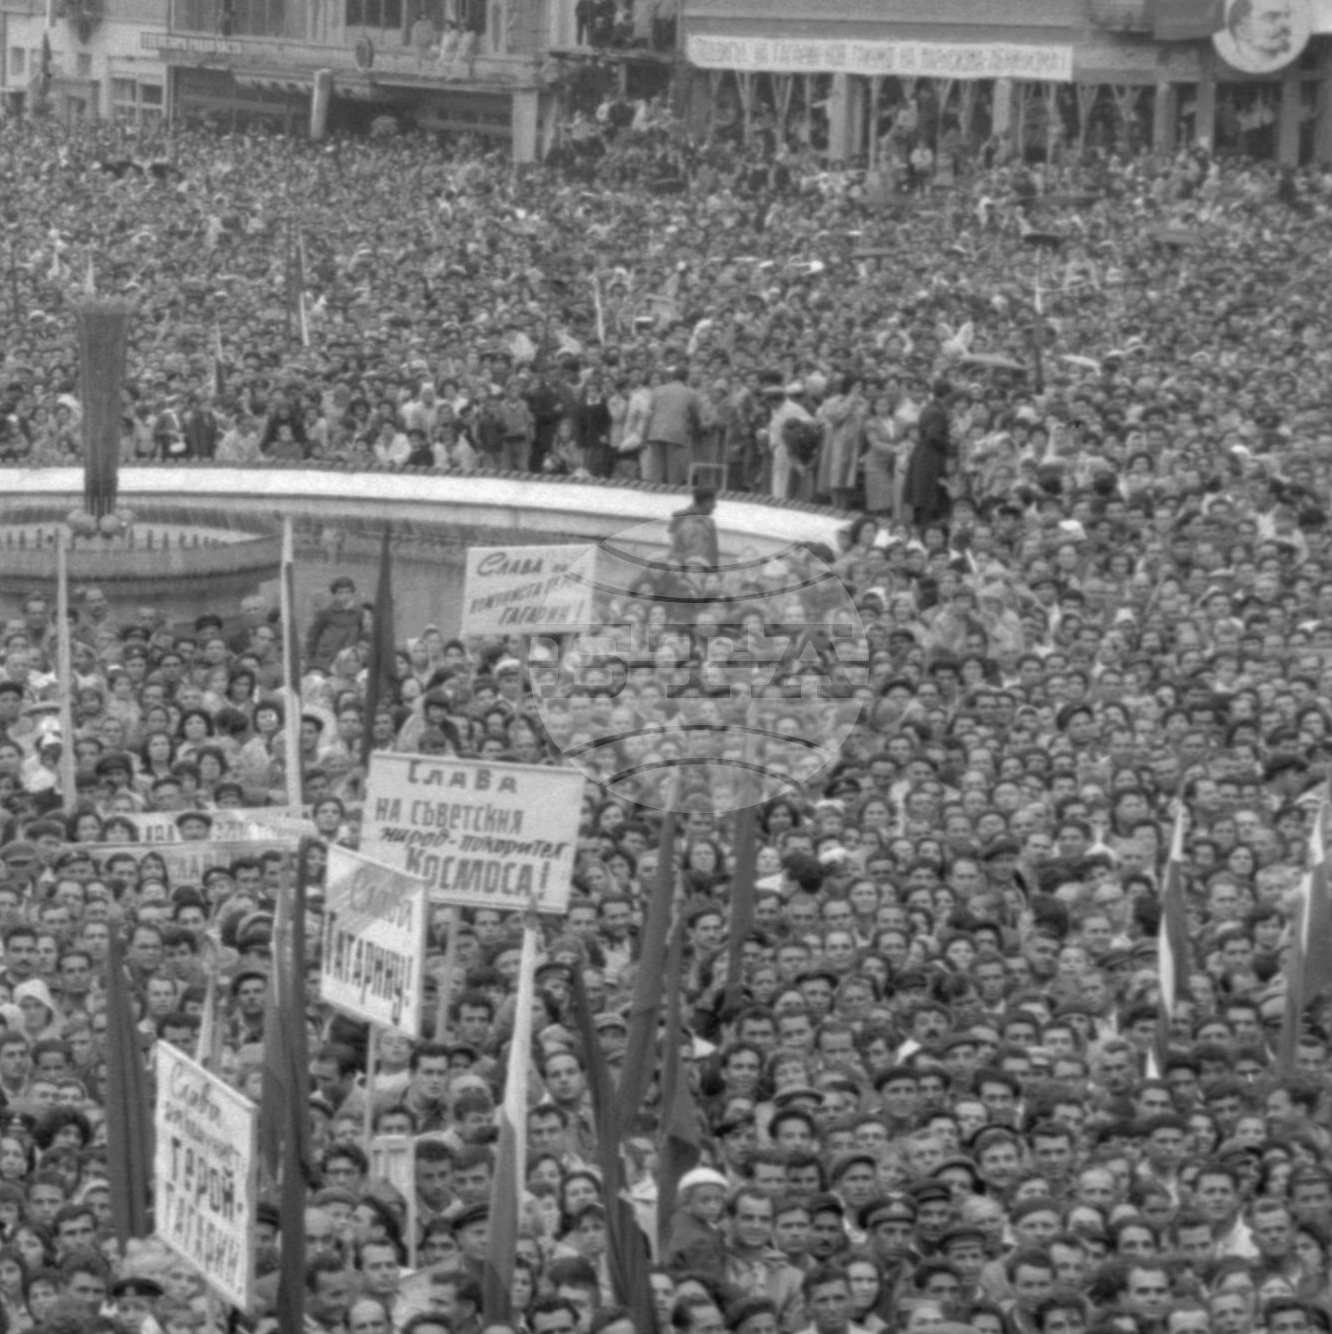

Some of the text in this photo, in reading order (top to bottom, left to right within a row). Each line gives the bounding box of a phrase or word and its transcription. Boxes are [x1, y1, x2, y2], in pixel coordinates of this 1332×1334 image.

[409, 760, 517, 793] СЛАВА
[375, 797, 525, 835] НА СЪВЕТСКИЯ
